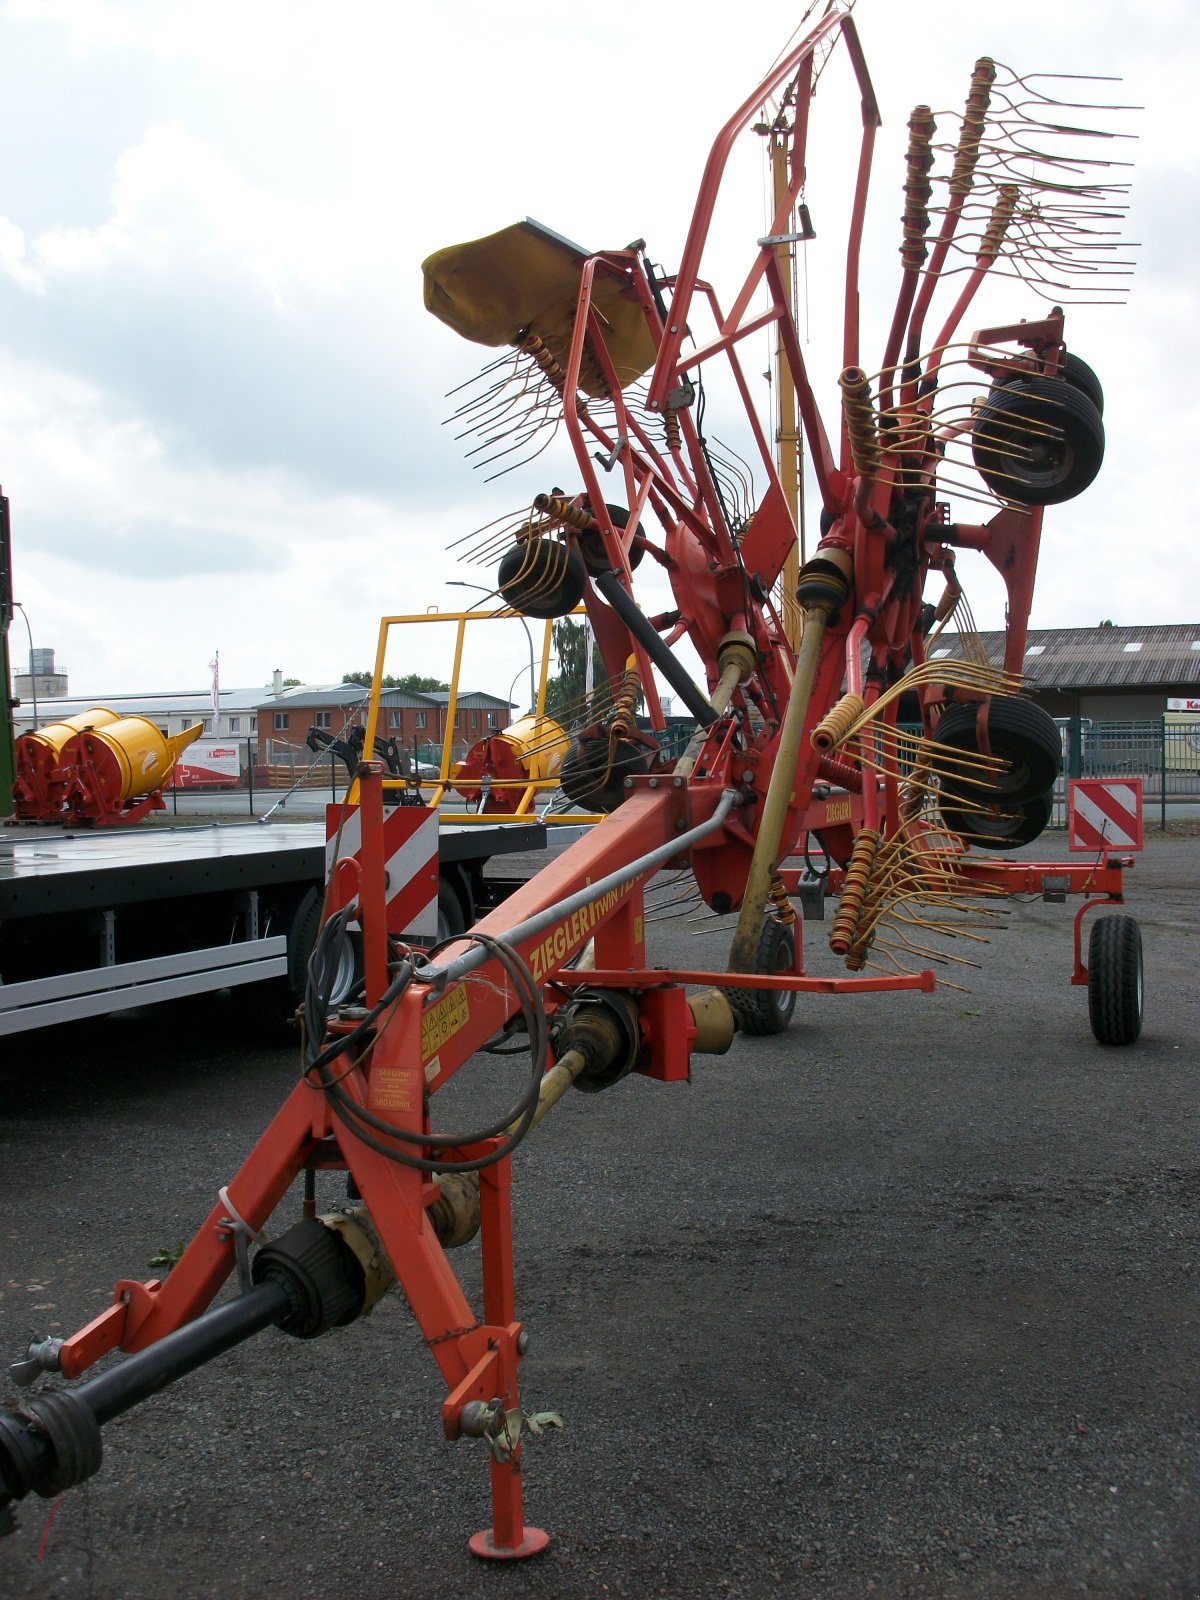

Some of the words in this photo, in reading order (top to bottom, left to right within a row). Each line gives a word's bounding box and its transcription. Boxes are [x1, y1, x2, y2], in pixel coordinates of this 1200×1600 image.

[826, 800, 849, 822] ZIEGLER
[530, 907, 589, 981] ZIEGLER
[595, 888, 619, 920] TWIN
